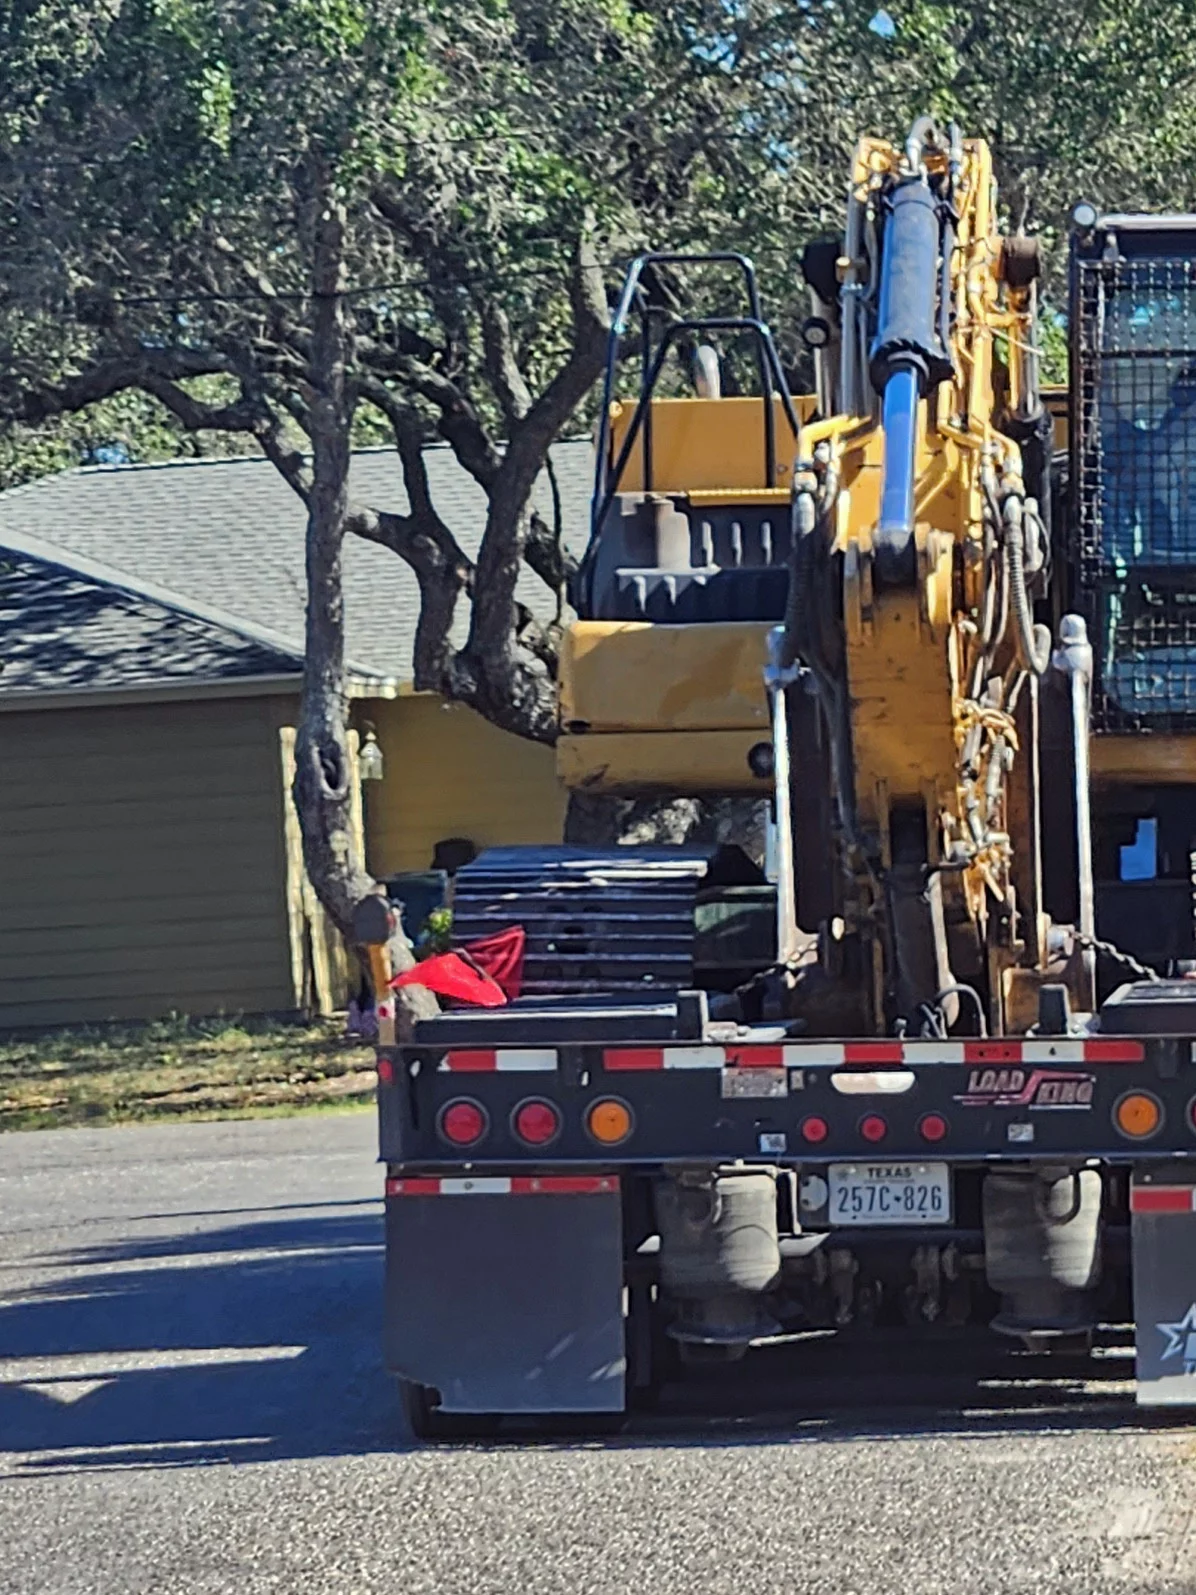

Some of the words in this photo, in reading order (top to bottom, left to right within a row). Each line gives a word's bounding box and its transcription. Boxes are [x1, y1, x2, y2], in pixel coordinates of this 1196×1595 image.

[967, 1069, 1025, 1093] LOAD
[1035, 1081, 1094, 1104] KING
[867, 1167, 912, 1178] TEXAS
